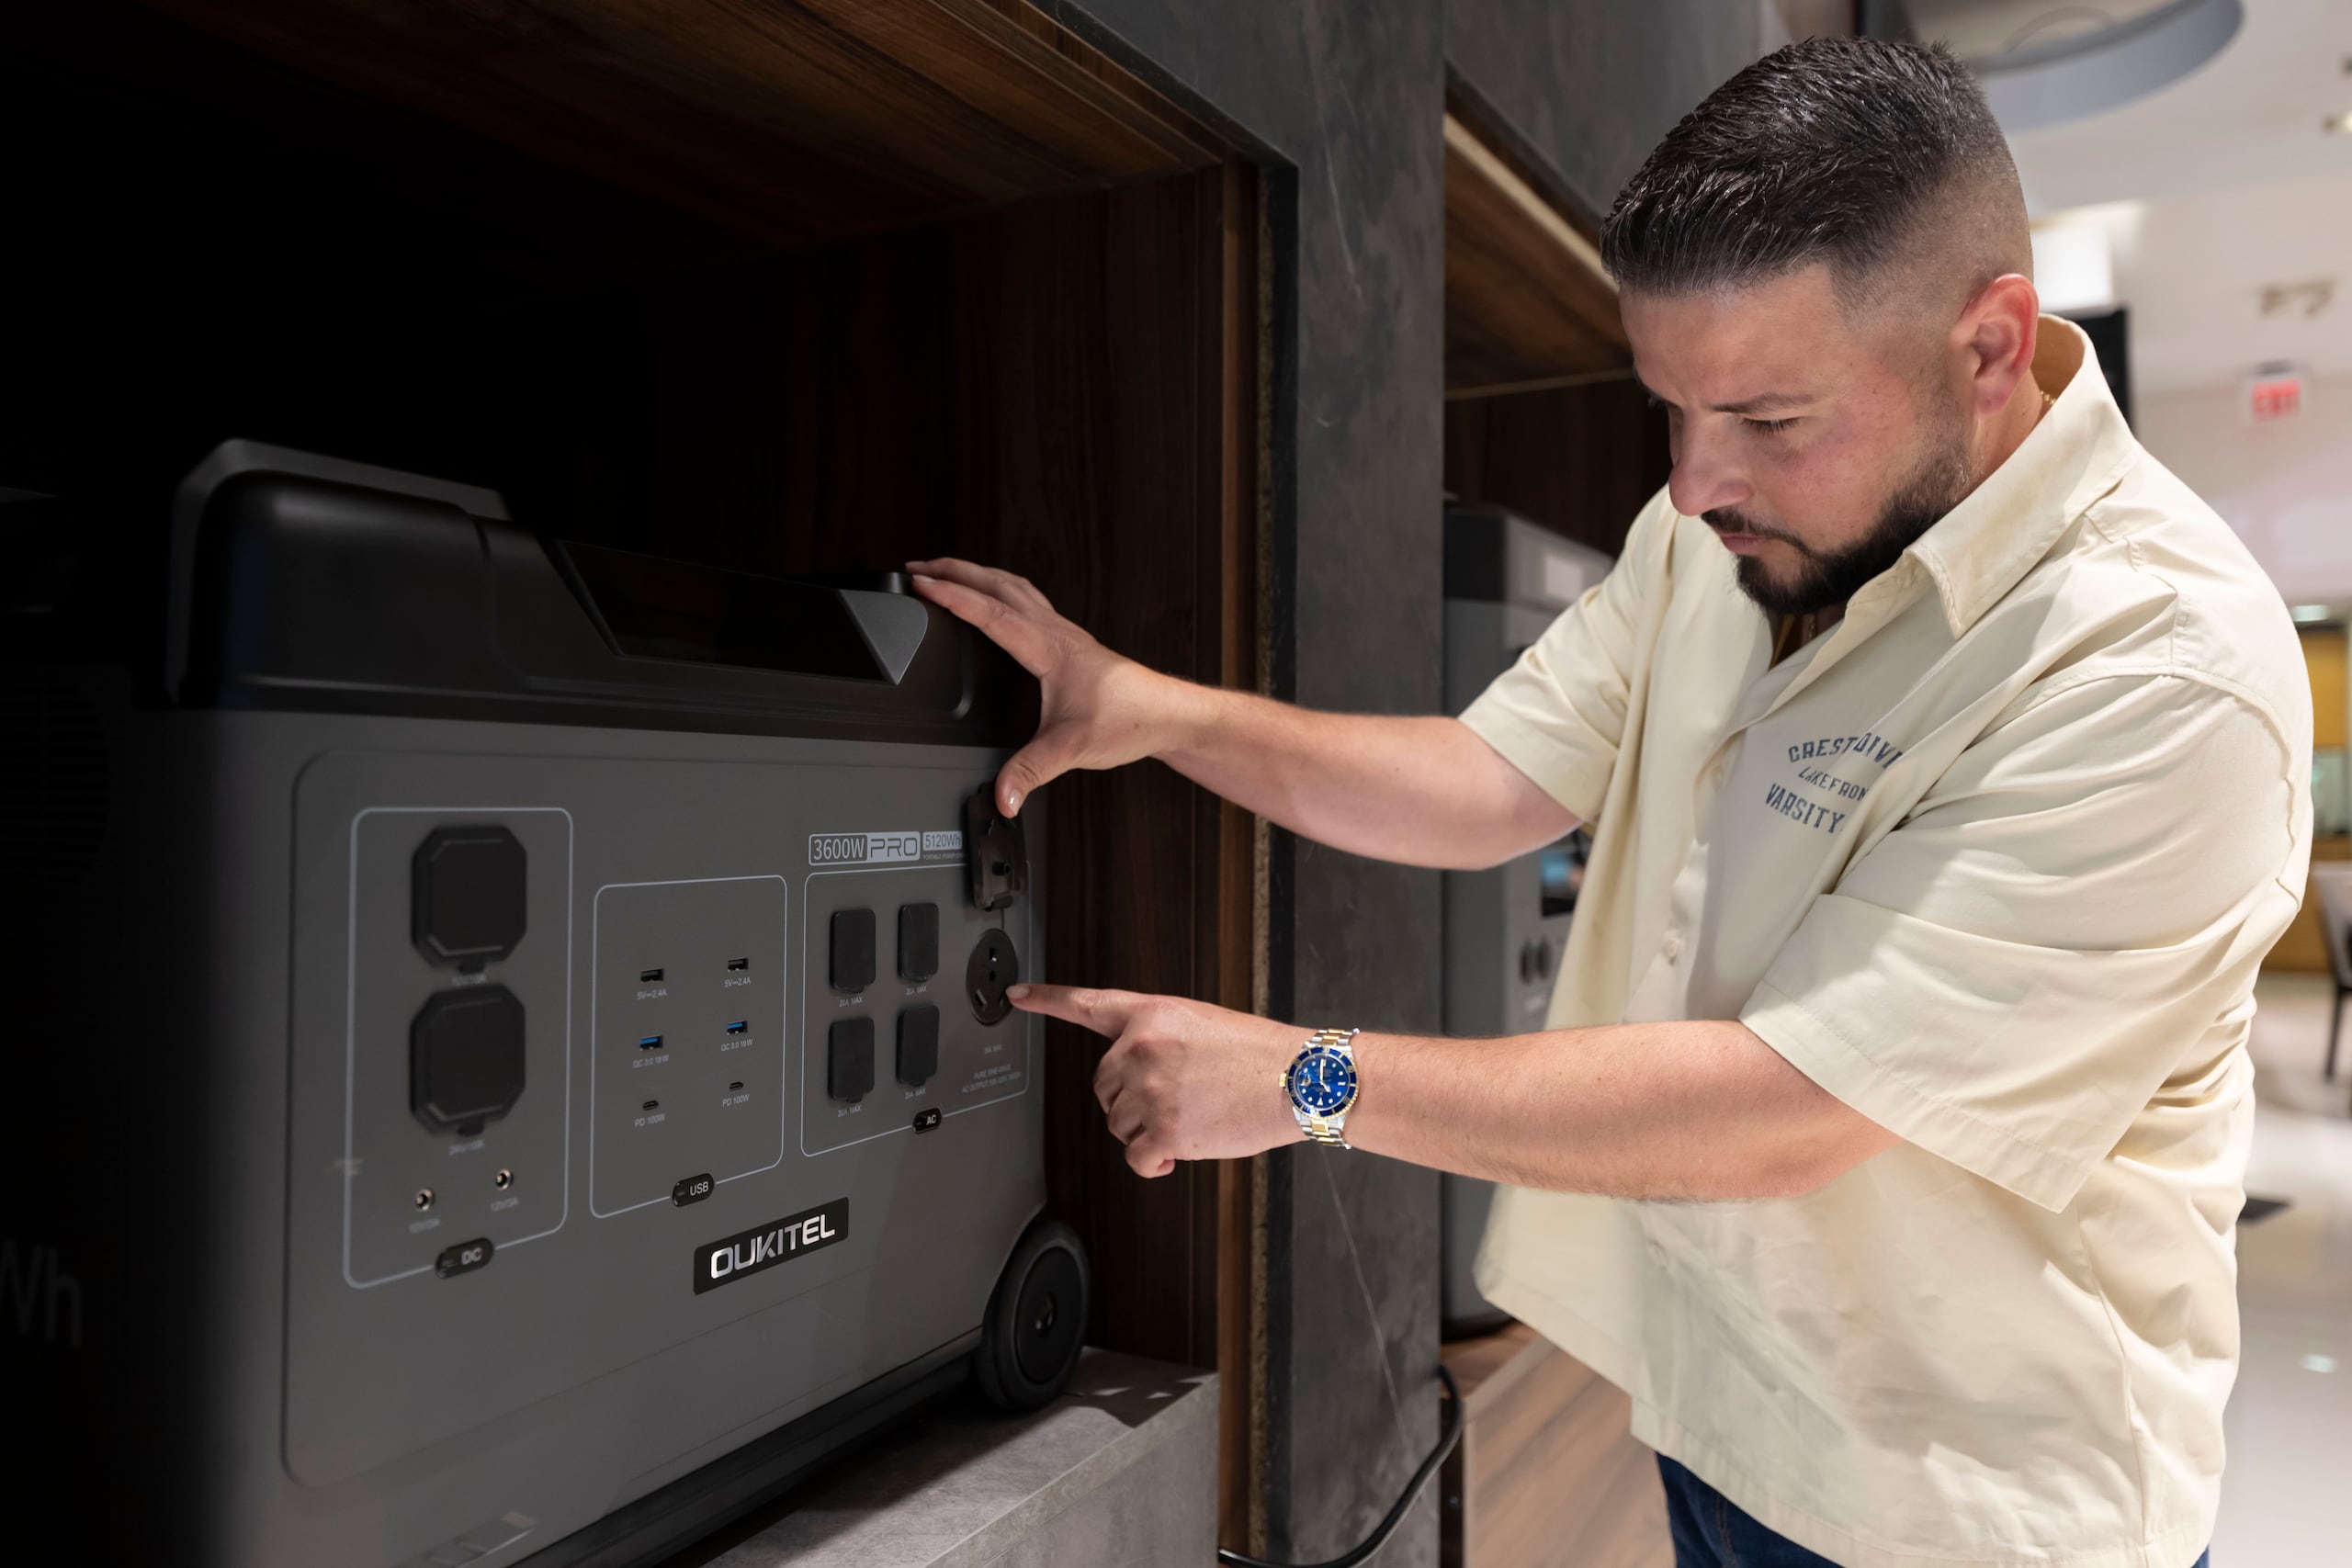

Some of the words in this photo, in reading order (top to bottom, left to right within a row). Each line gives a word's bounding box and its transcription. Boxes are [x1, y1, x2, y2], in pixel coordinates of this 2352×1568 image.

[1765, 783, 1846, 834] VARSITY
[813, 837, 865, 861] 3600W
[870, 838, 917, 856] PRO
[925, 833, 962, 849] 5120Wh
[926, 1114, 937, 1124] AC
[689, 1181, 709, 1196] USB
[461, 1247, 483, 1266] DC
[710, 1213, 836, 1280] OUKITEL
